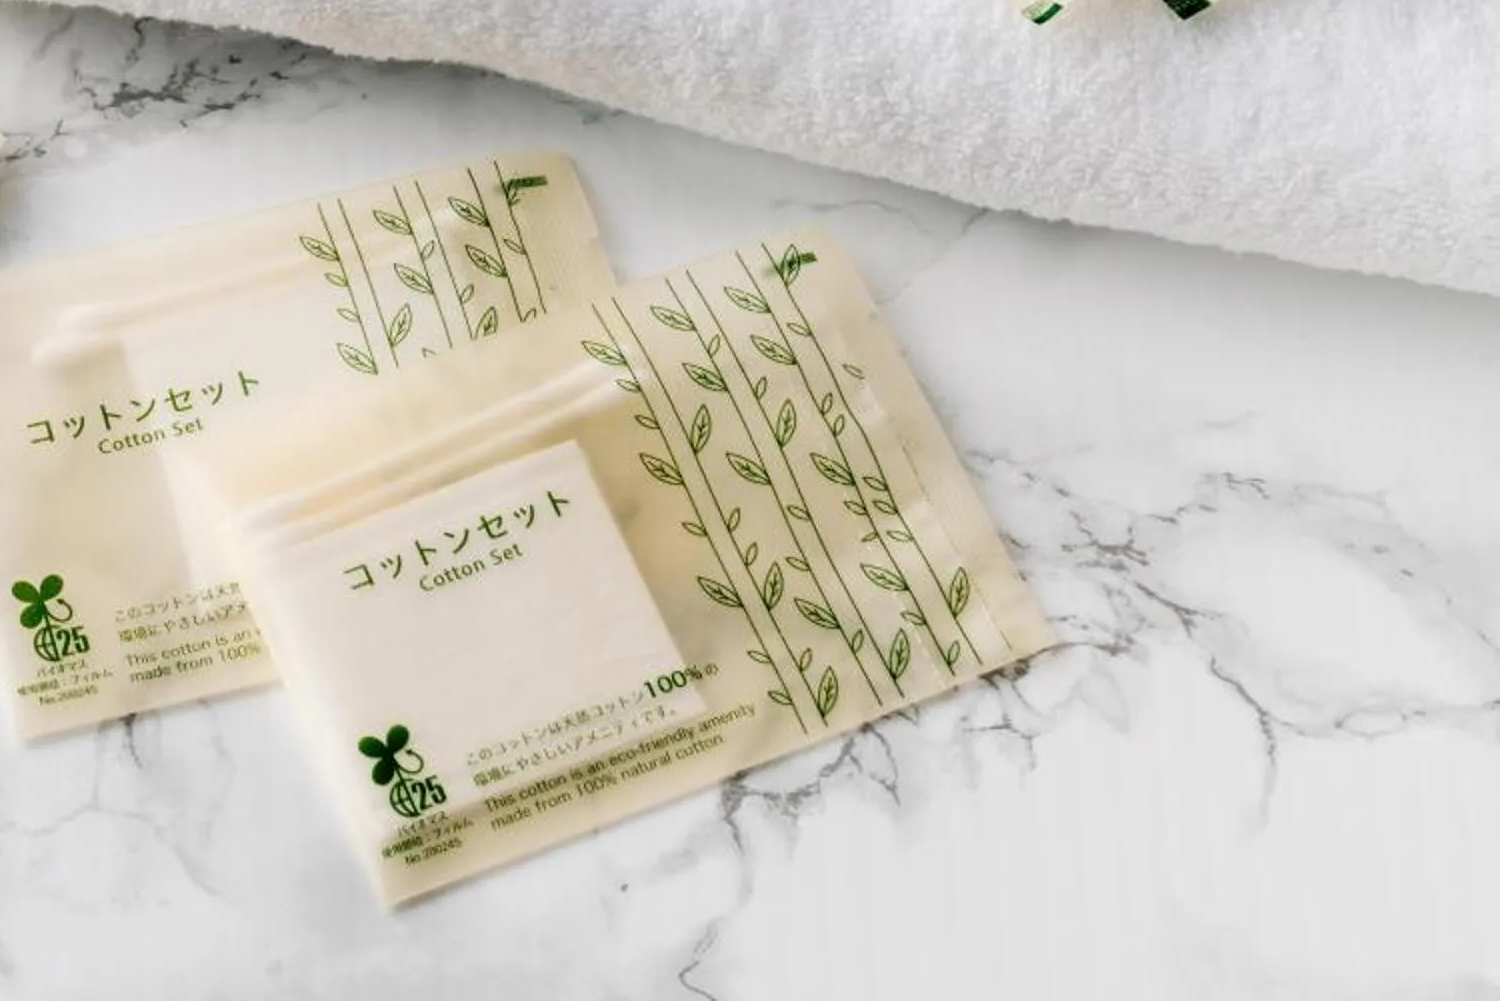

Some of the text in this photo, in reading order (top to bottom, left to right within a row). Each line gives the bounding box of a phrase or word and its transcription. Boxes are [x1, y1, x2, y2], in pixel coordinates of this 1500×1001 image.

[28, 368, 260, 446] コットンセット
[97, 416, 203, 454] Cotton Set
[344, 487, 571, 590] コットンセット
[418, 542, 522, 592] Cotton Set
[56, 626, 89, 656] 25
[125, 649, 156, 666] This
[161, 638, 210, 659] cotton
[215, 633, 228, 646] is
[129, 663, 171, 682] made
[176, 654, 213, 672] from
[484, 701, 759, 813] This cotton is an eco-friendly amenity
[411, 775, 446, 809] 25
[489, 732, 726, 831] made from 100% natural cotton
